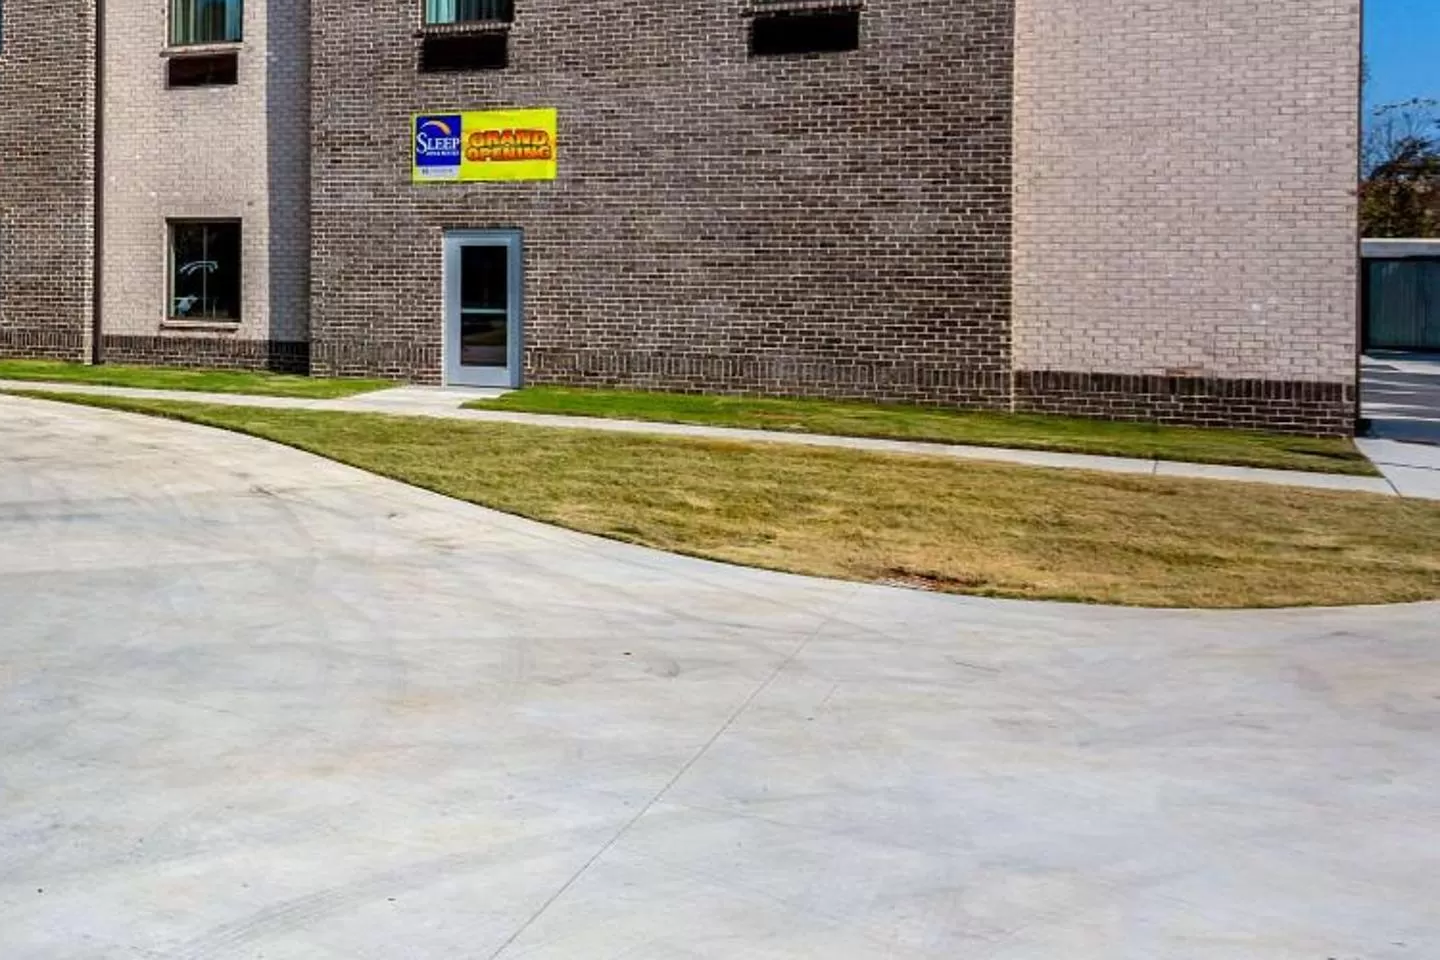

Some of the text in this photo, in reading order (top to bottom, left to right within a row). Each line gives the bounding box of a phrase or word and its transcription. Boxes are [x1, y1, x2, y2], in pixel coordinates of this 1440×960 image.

[416, 132, 459, 154] SLEEP
[468, 130, 550, 147] GRAND
[466, 146, 551, 161] OPENING
